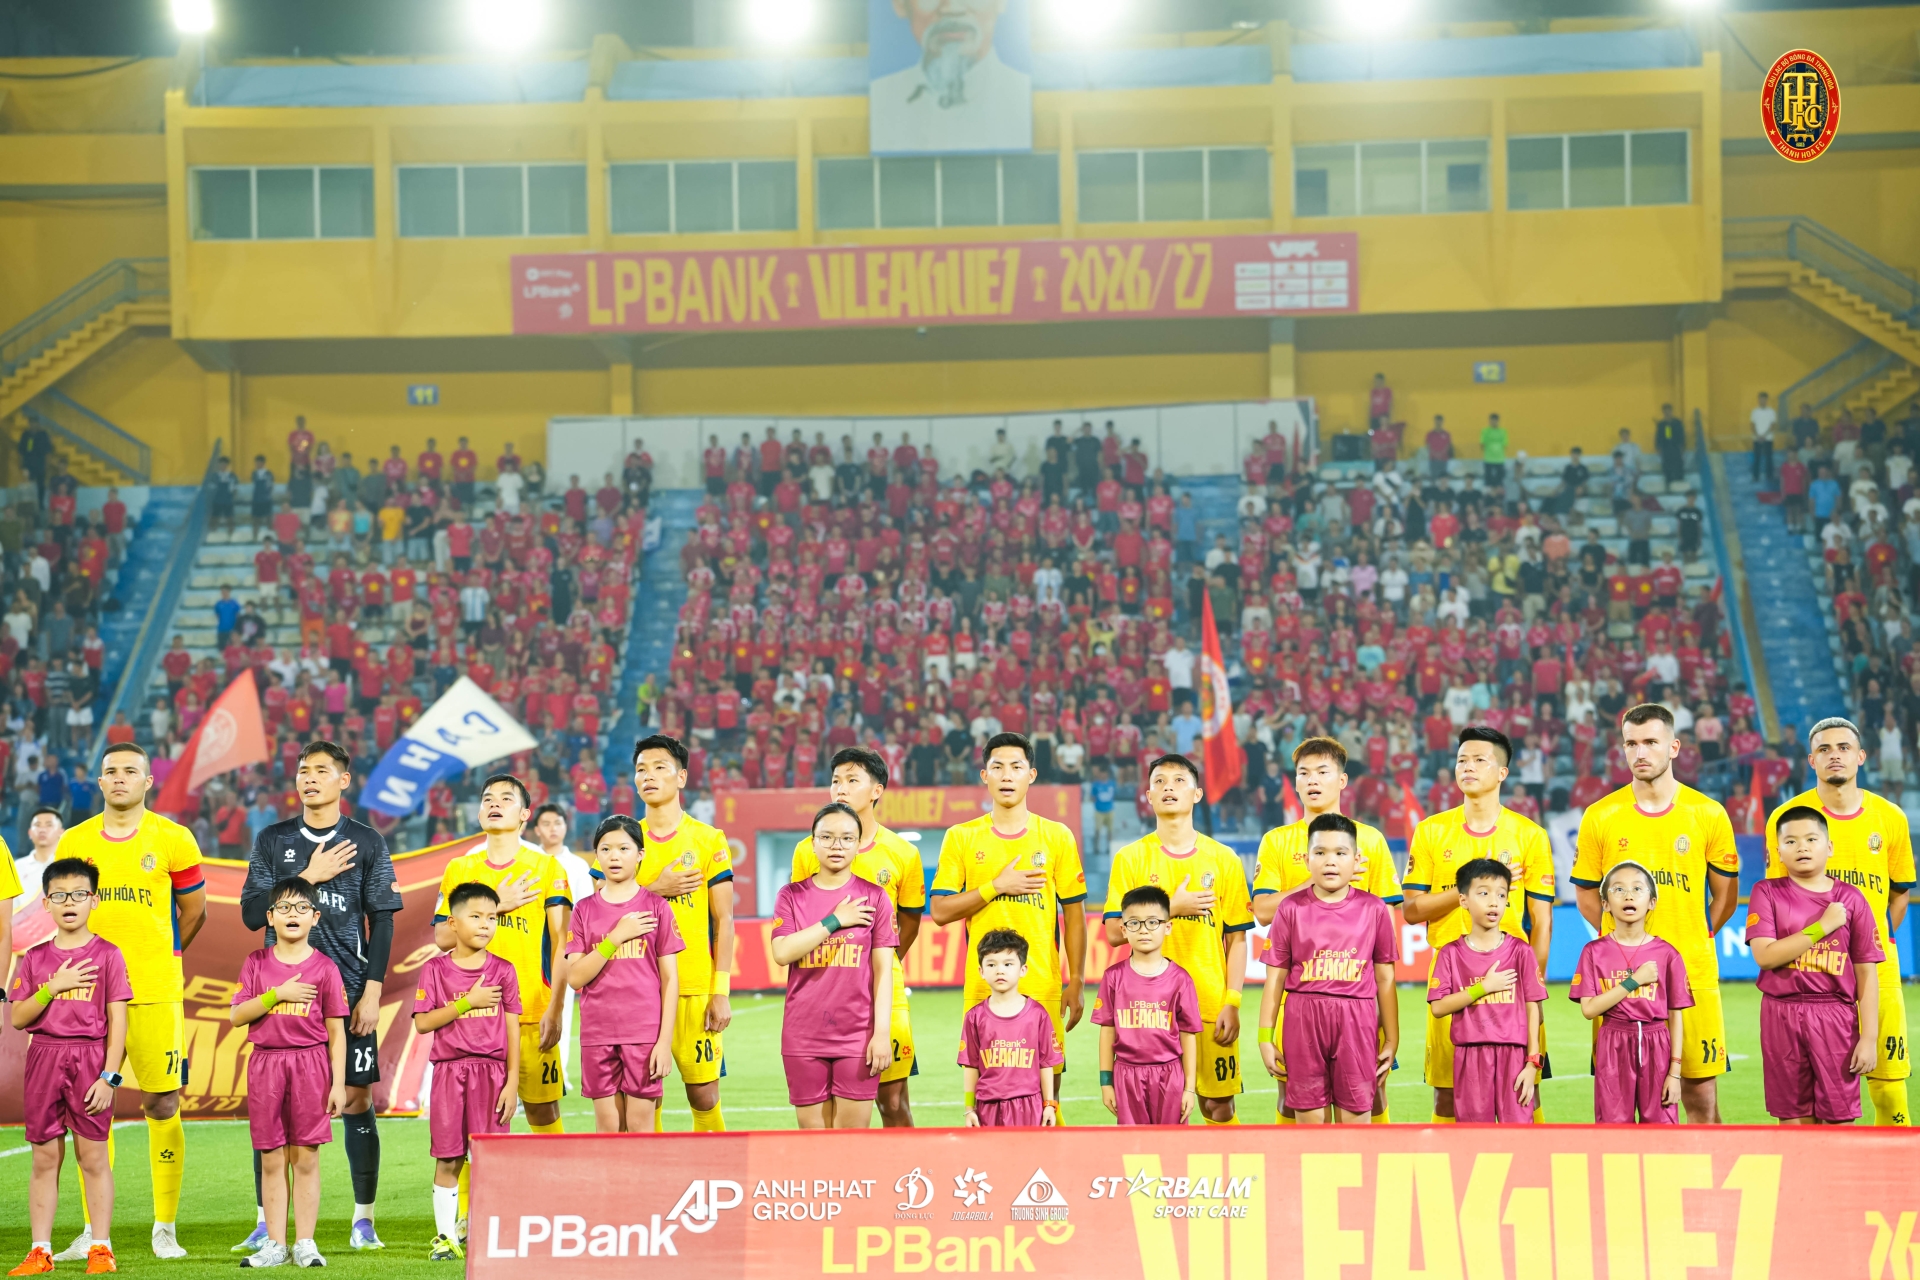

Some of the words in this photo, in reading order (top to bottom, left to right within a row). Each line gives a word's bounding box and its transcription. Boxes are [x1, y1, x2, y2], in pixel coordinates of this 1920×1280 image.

[586, 254, 781, 325] LPBANK
[808, 246, 1021, 320] VLEAGUE1
[1060, 242, 1213, 313] 2026/27
[1676, 873, 1690, 893] FC
[1868, 874, 1883, 894] FC
[114, 884, 136, 903] HÓA
[138, 888, 152, 907] FC
[331, 893, 346, 912] FC
[516, 916, 528, 934] FC
[822, 935, 847, 945] Bank
[1313, 949, 1351, 959] LPBank
[1129, 1000, 1160, 1010] LPBank
[991, 1039, 1021, 1049] LPBank
[1886, 1035, 1904, 1060] 98
[165, 1049, 179, 1075] 77
[354, 1046, 372, 1073] 25
[980, 1047, 1035, 1069] VLEAGUE1
[1214, 1055, 1236, 1082] 89
[541, 1059, 559, 1085] 26
[487, 1215, 678, 1259] LPBank
[822, 1226, 1037, 1274] LPBank
